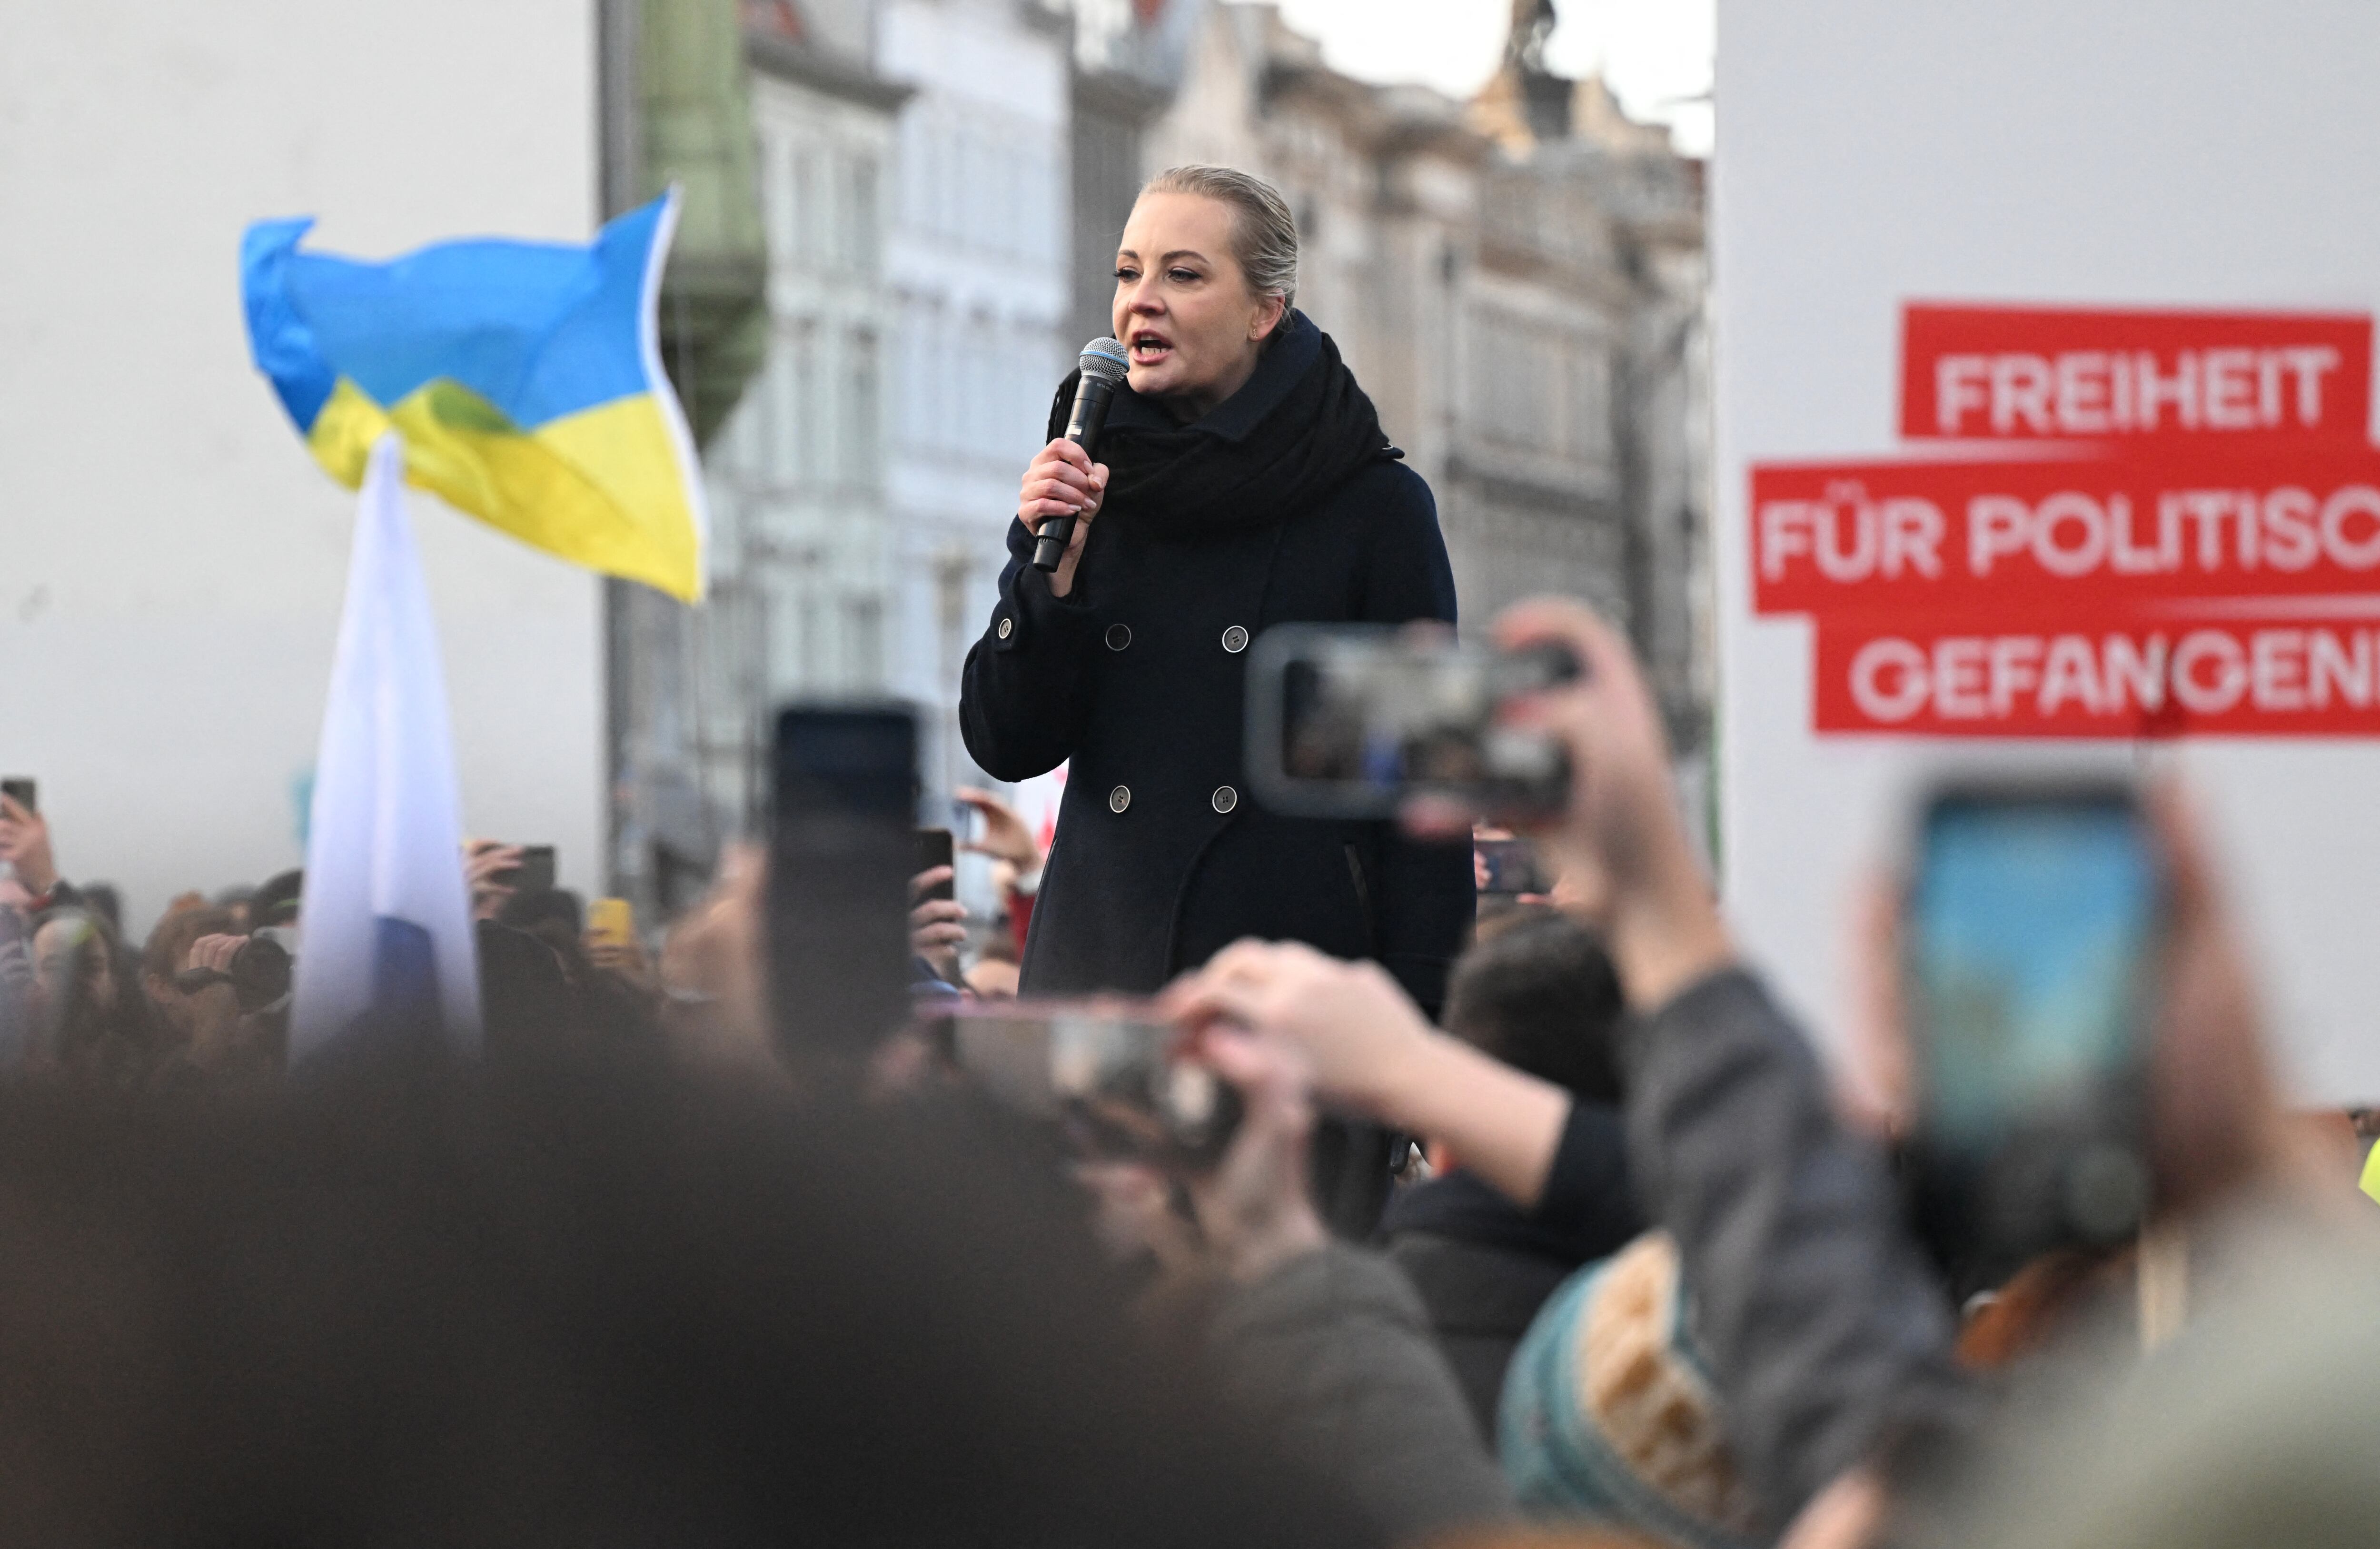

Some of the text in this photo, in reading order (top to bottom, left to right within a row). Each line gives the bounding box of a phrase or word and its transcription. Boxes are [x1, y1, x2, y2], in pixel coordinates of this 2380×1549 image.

[1935, 347, 2338, 434] FREIHEIT
[1758, 482, 2380, 582] FÜR POLITISC
[1849, 630, 2380, 722] GEFANGEN
